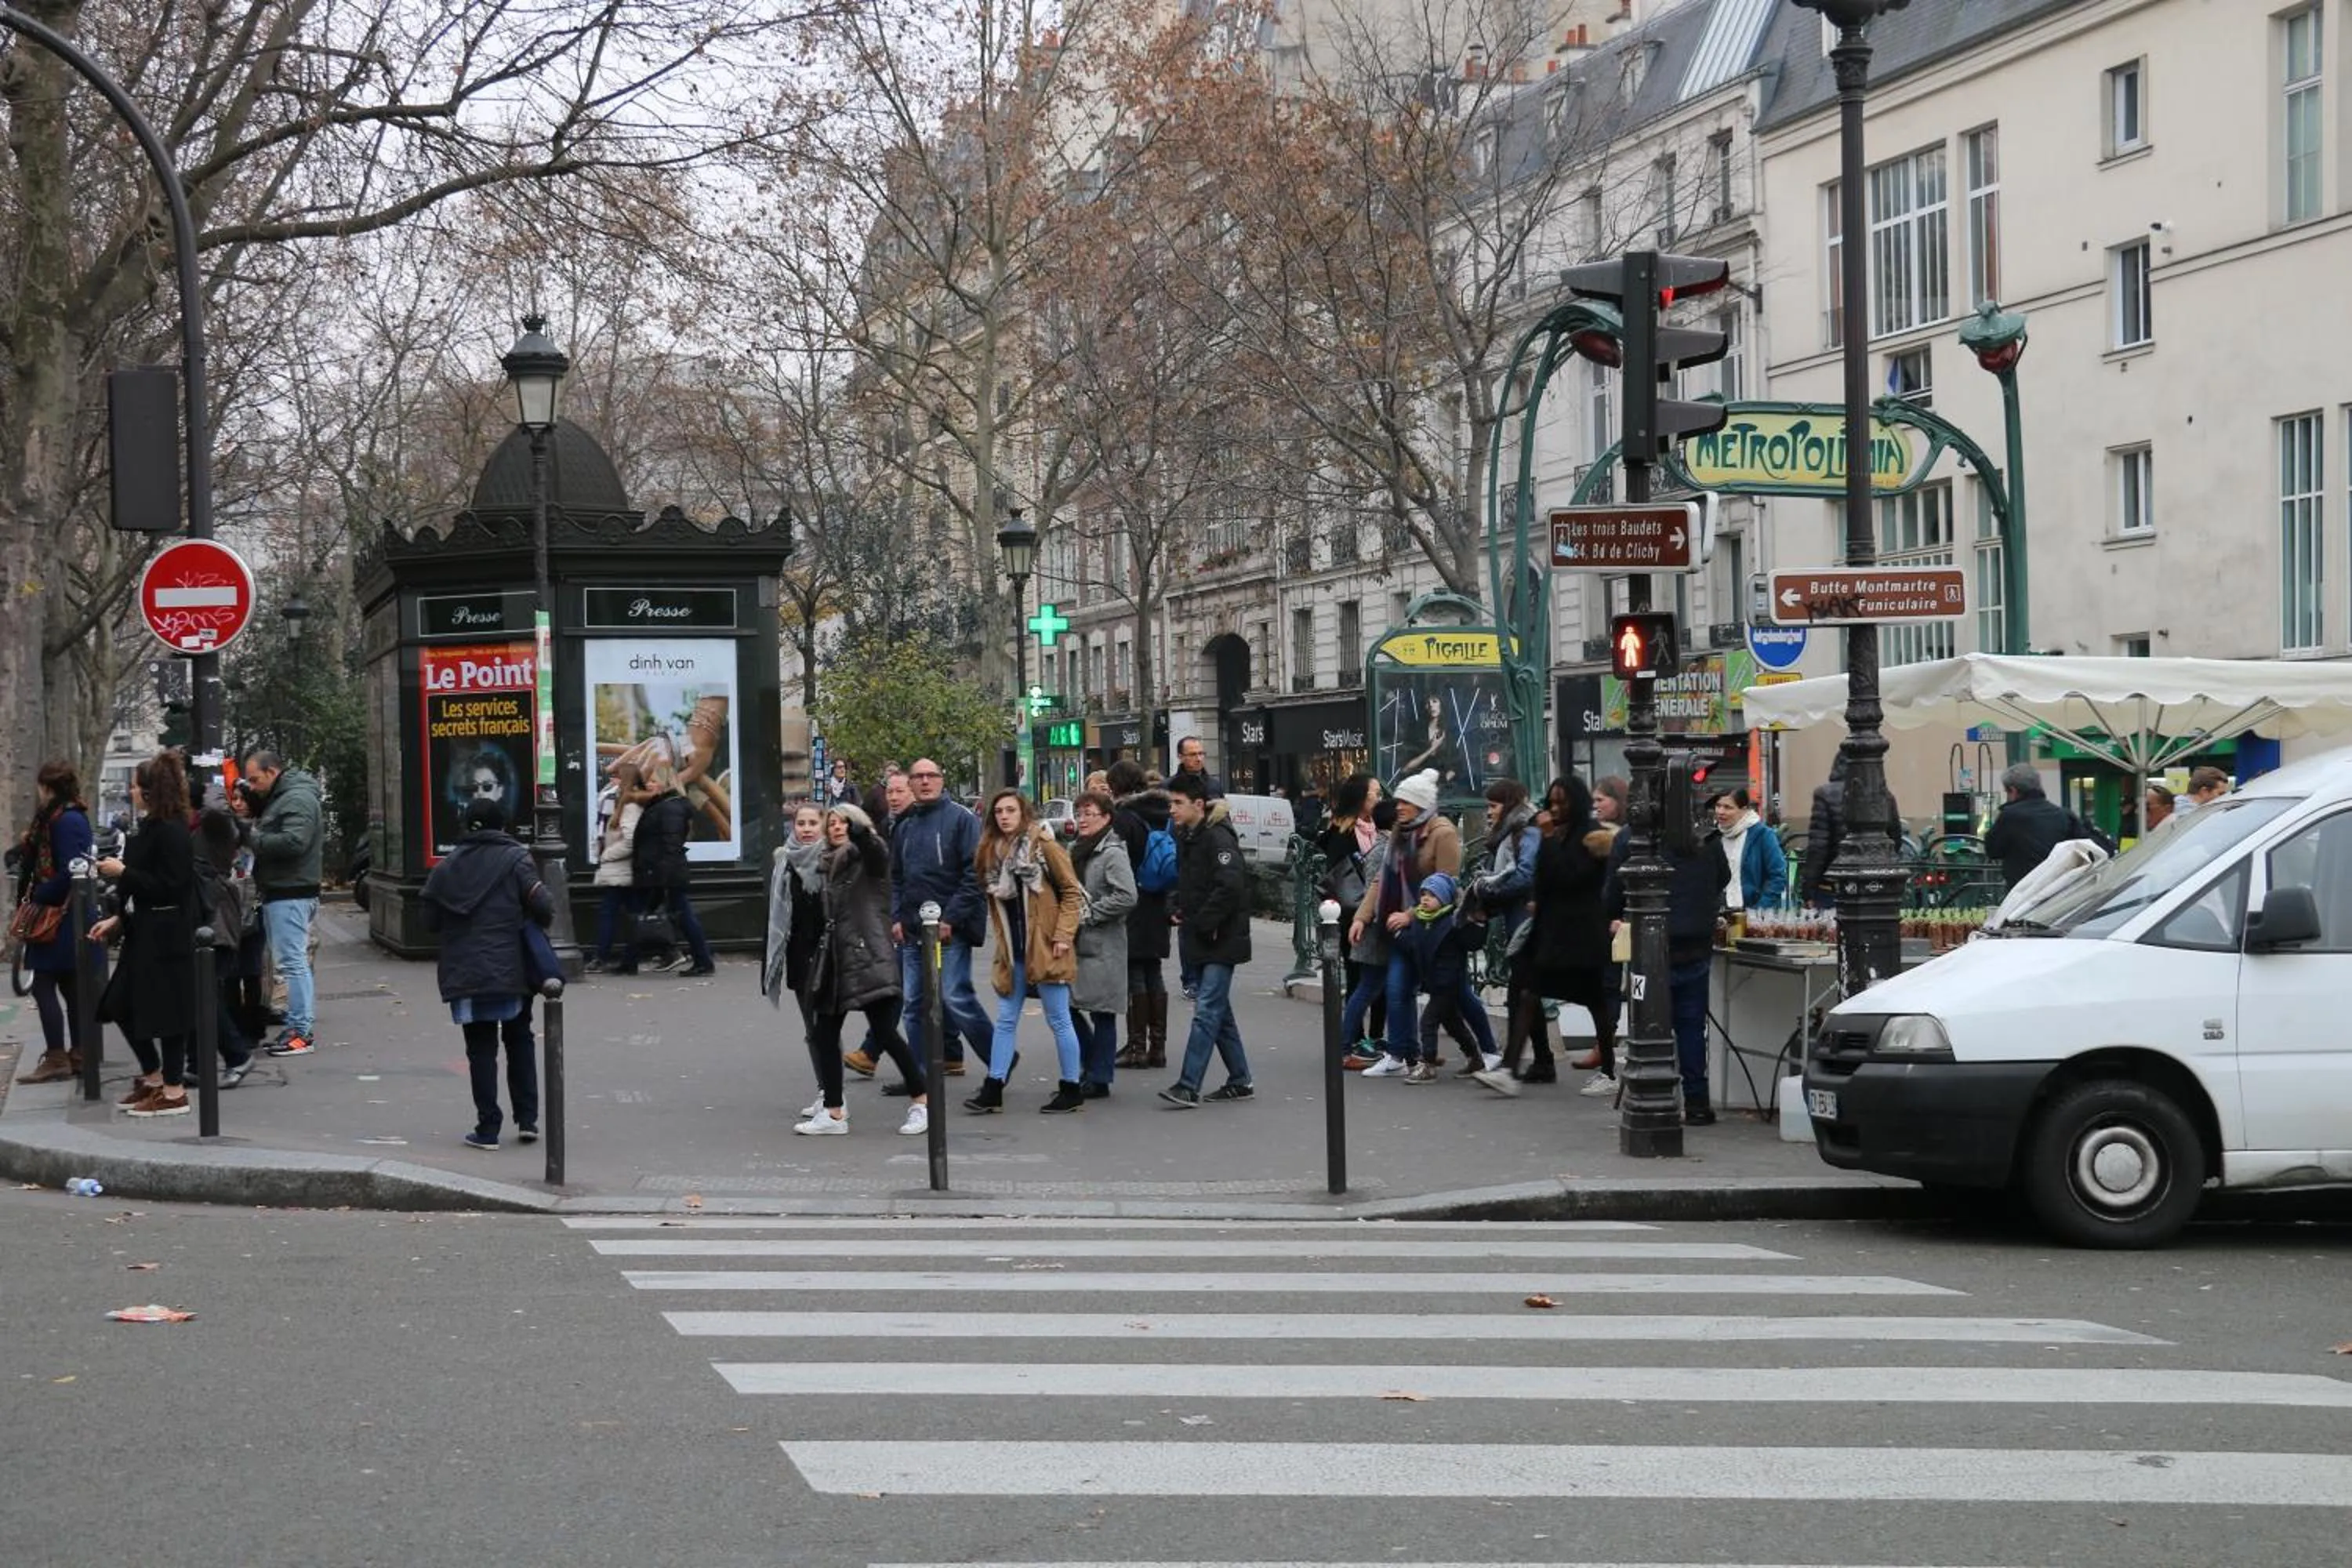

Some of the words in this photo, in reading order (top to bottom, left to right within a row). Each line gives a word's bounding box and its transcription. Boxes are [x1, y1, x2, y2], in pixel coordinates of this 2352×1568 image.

[1696, 419, 1904, 479] METROPOLIIN
[1572, 521, 1587, 536] Les
[1592, 523, 1616, 535] trois
[1621, 520, 1661, 535] Baudets
[1592, 543, 1605, 559] Bd
[1610, 543, 1621, 558] de
[1626, 543, 1660, 561] Clichy
[1810, 581, 1848, 594] Butte
[1854, 579, 1936, 593] Montmartre
[451, 605, 502, 624] Presse
[628, 597, 691, 618] Presse
[1858, 598, 1937, 612] Funiculaire
[1425, 637, 1487, 660] PIGALLE
[630, 653, 662, 670] dinh
[666, 659, 694, 670] van
[425, 664, 456, 689] Le
[459, 656, 534, 688] Point
[1653, 672, 1721, 691] MENTATION
[442, 699, 463, 717] Les
[466, 697, 518, 716] services
[1654, 699, 1709, 717] ENERALE
[432, 717, 477, 737] secrets
[480, 714, 530, 739] français
[1583, 710, 1603, 732] Sta
